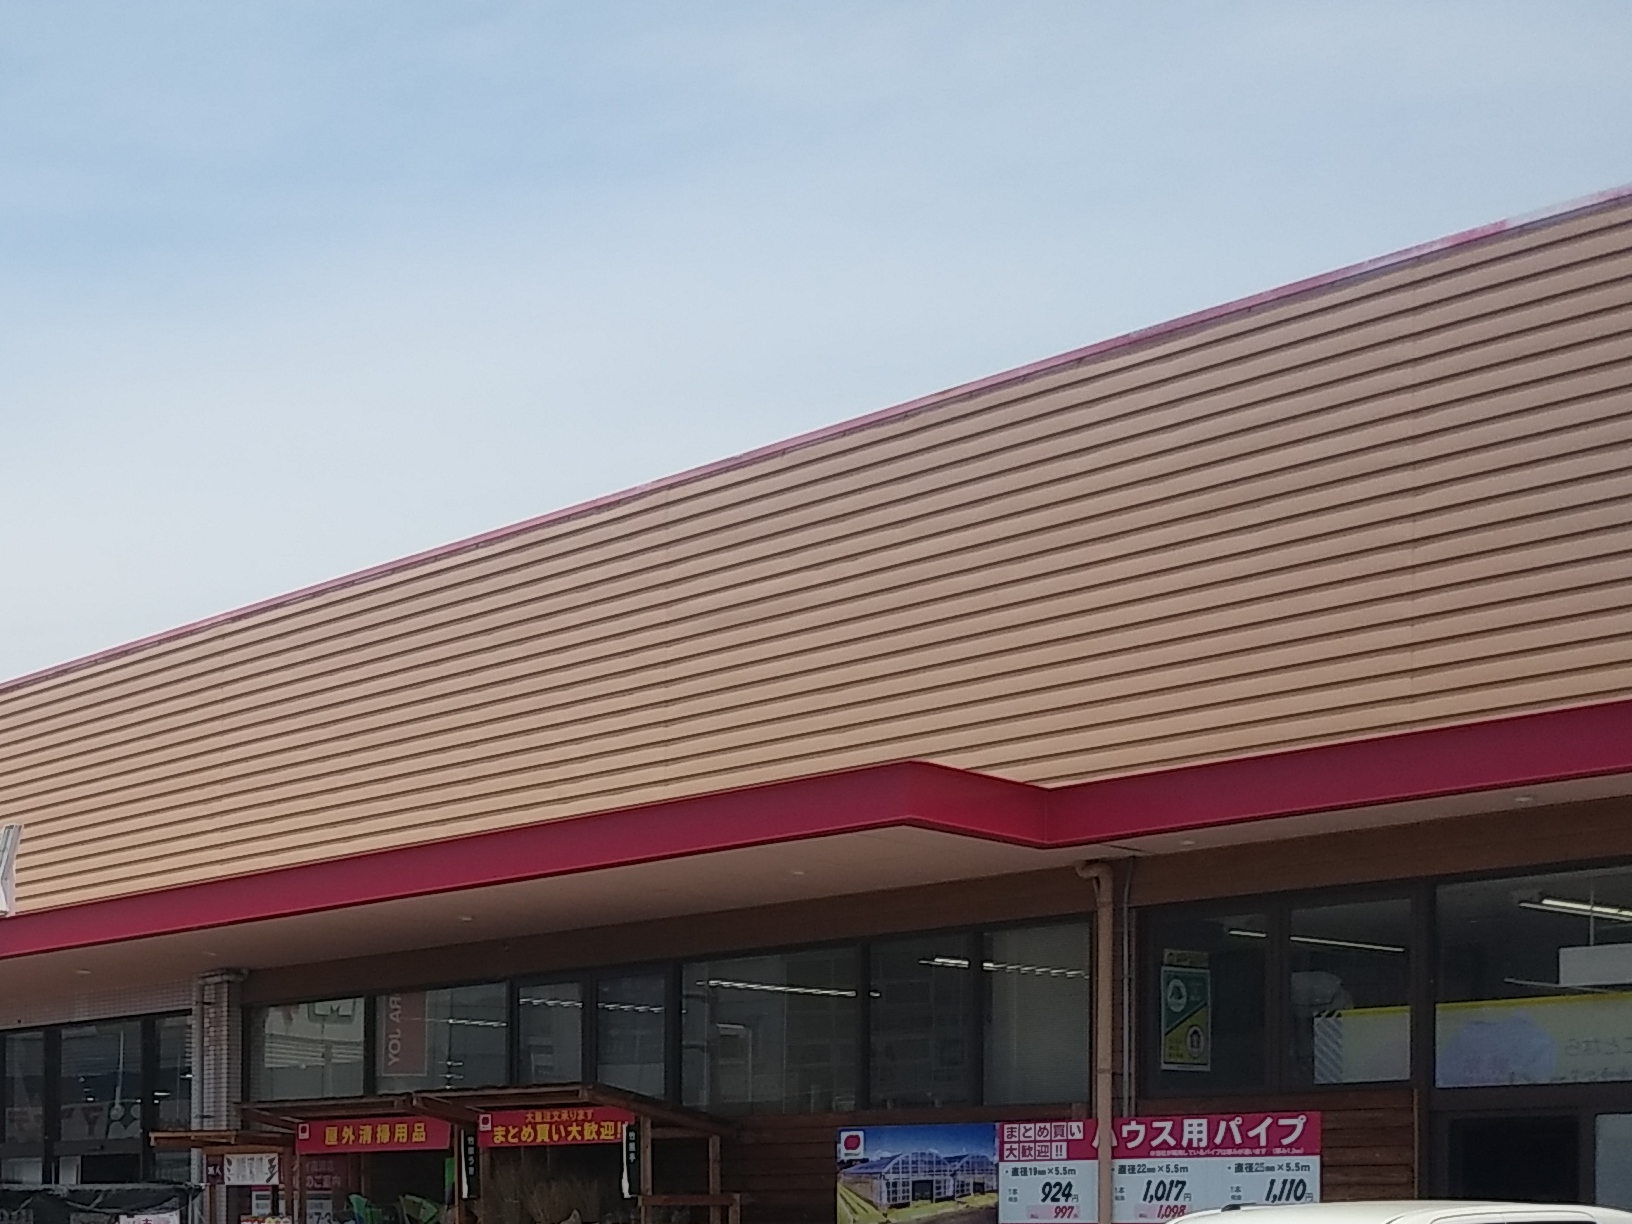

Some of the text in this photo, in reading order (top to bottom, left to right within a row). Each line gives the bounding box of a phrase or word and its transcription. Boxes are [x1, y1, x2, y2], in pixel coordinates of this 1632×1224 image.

[1005, 1122, 1083, 1140] まとめ買い
